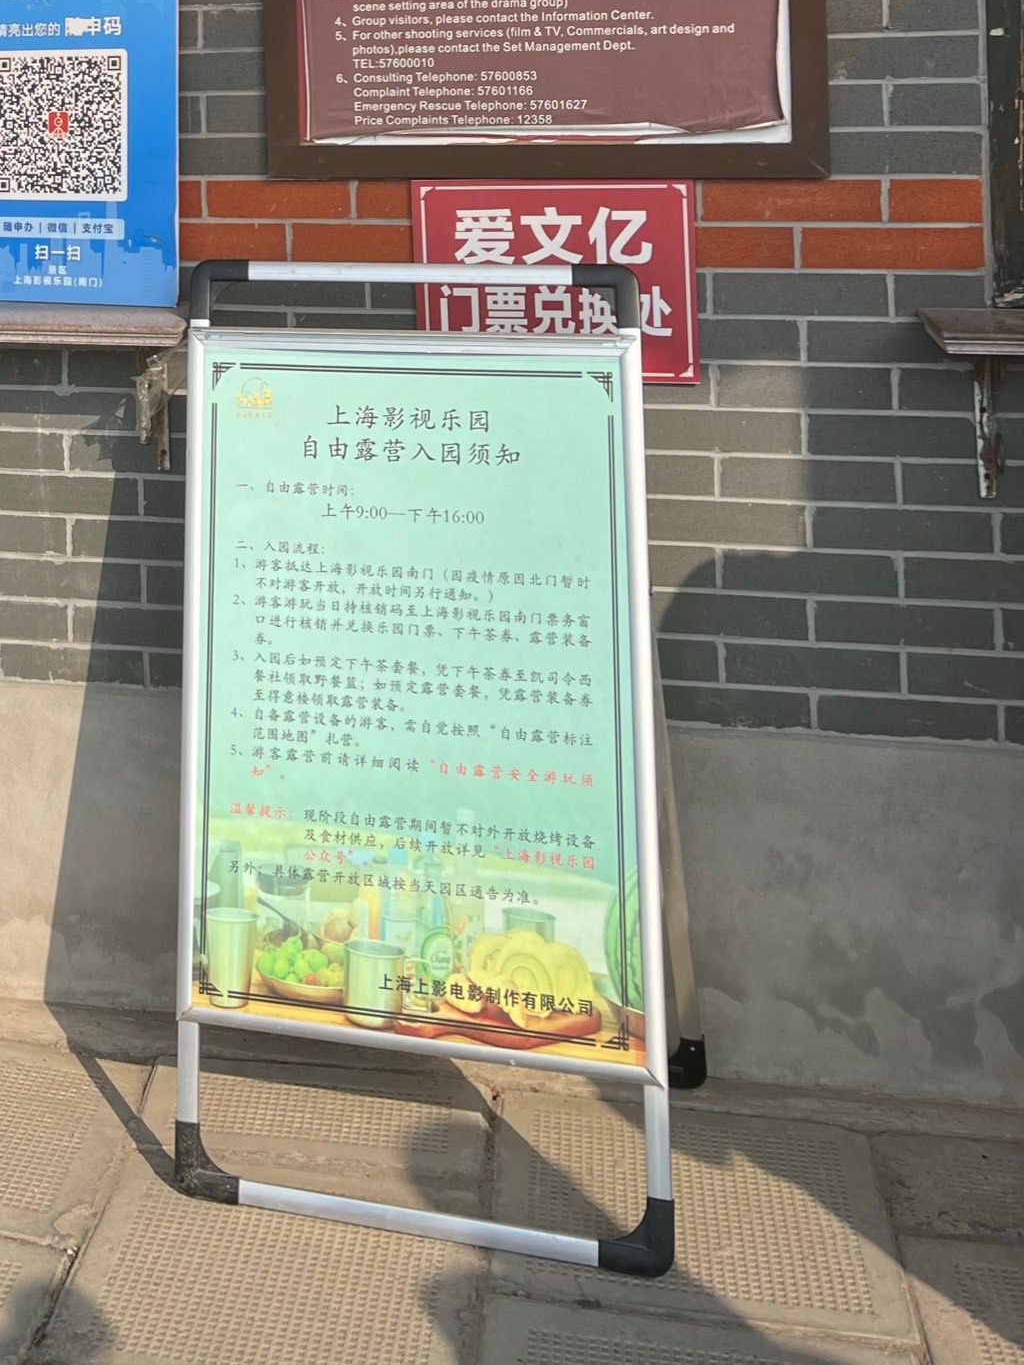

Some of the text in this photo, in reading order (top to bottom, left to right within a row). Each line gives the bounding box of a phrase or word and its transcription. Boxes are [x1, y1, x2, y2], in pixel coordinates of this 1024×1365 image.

[354, 72, 413, 84] Consulting
[416, 71, 478, 84] Telephone:
[481, 71, 537, 81] 57600853
[48, 223, 67, 233] 微信
[82, 223, 113, 234] 支付宝
[454, 207, 653, 266] 爱文亿
[35, 244, 80, 260] 扫一扫
[440, 285, 673, 337] 门票兑换处
[327, 405, 488, 432] 上海影视乐园
[304, 435, 520, 466] 自由露营入园须知
[379, 973, 594, 1017] 上海上影电影制作有限公司
